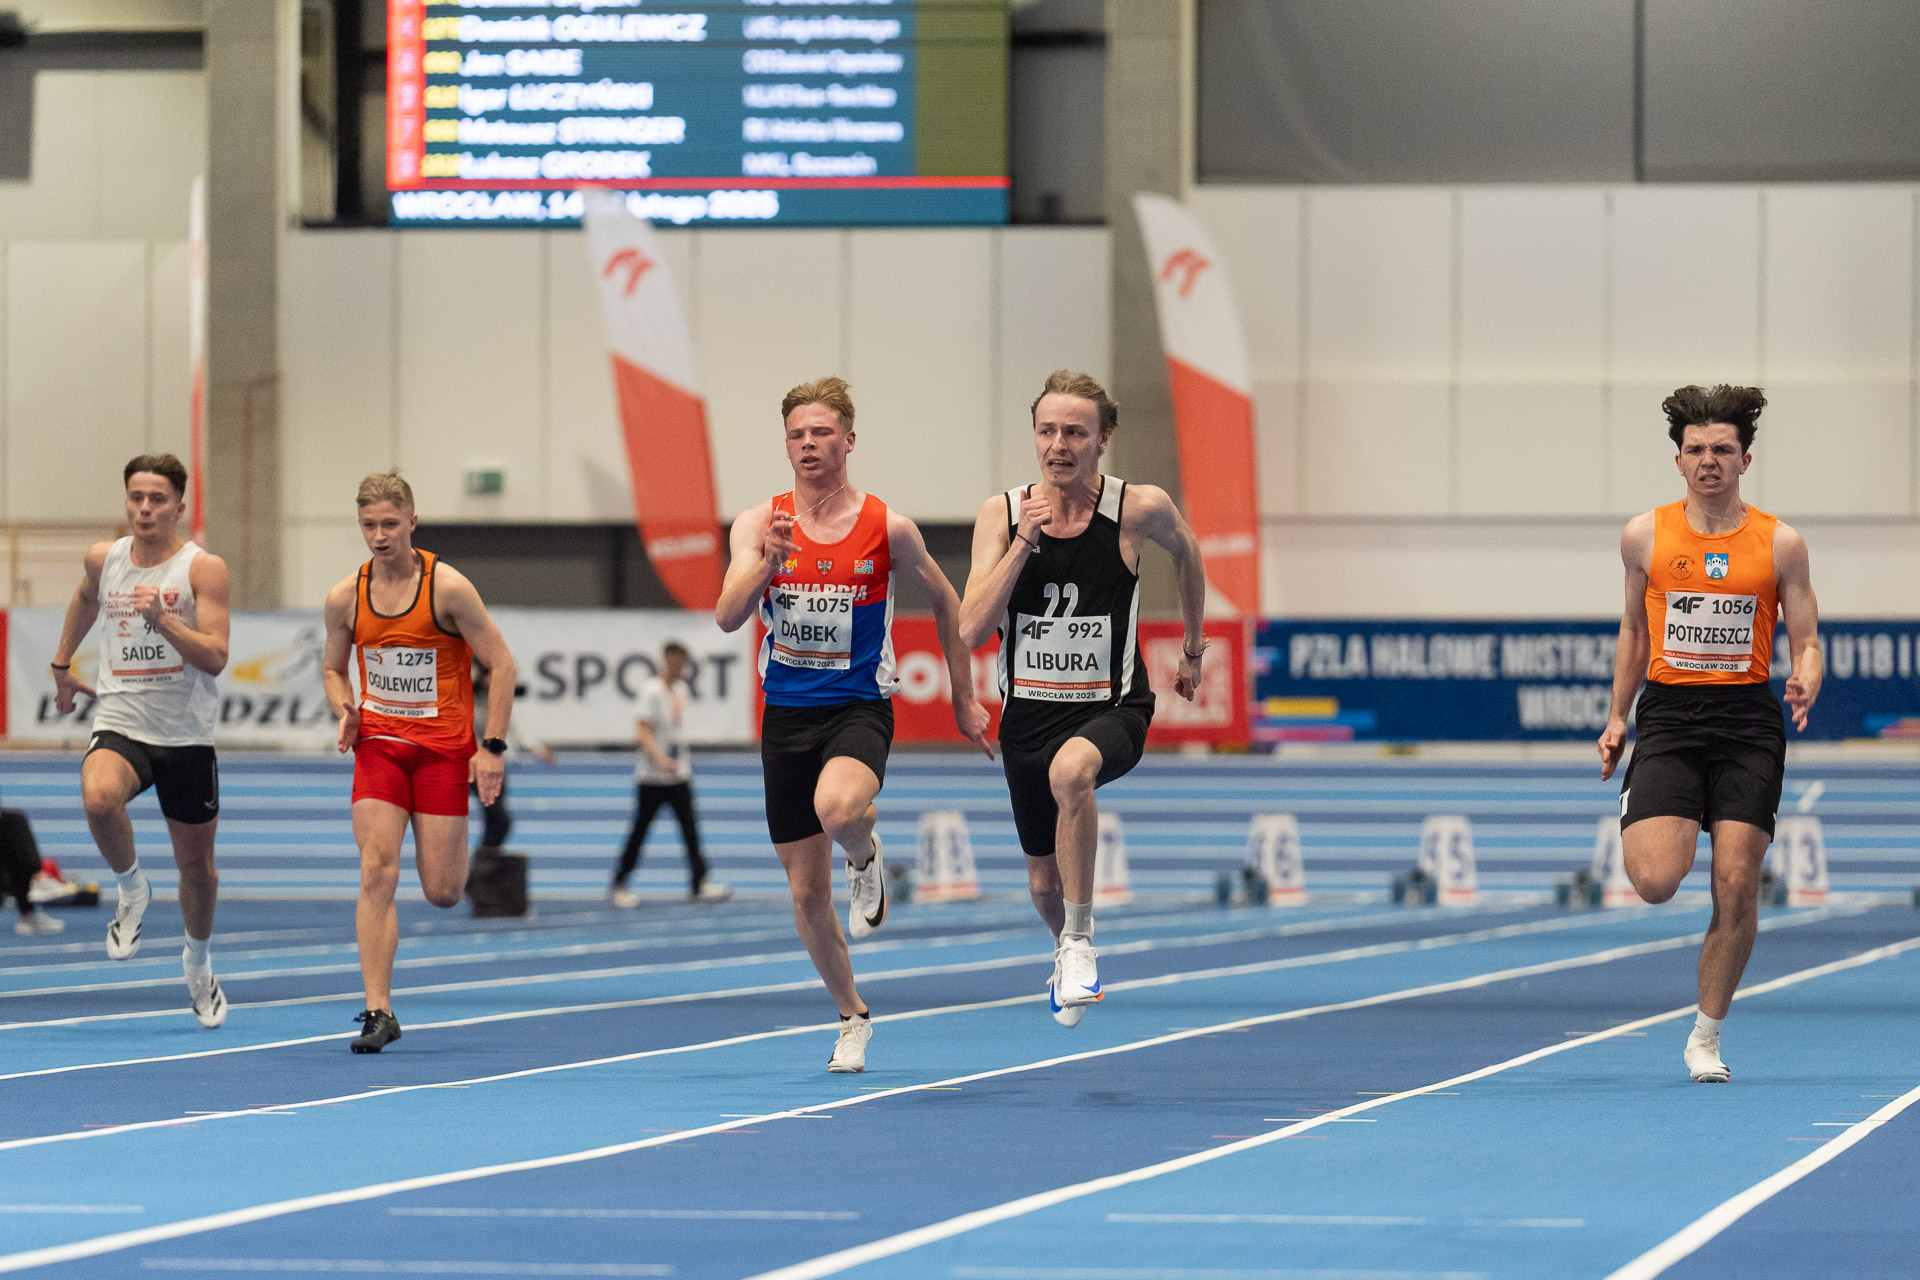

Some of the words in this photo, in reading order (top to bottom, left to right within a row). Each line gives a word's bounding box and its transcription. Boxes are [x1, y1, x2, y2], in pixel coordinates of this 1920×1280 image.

[807, 598, 849, 613] 1075
[1712, 599, 1753, 615] 1056
[781, 620, 837, 644] DĄBEK
[1068, 622, 1102, 639] 992
[1668, 624, 1750, 645] POTRZESZCZ
[122, 645, 166, 661] SAIDE
[396, 652, 434, 666] 1275
[1026, 651, 1099, 671] LIBURA
[1676, 661, 1718, 670] WROCŁAW
[368, 671, 433, 693] OGULEWICZ
[1028, 690, 1074, 699] WROCŁAW
[1075, 691, 1096, 699] 2025
